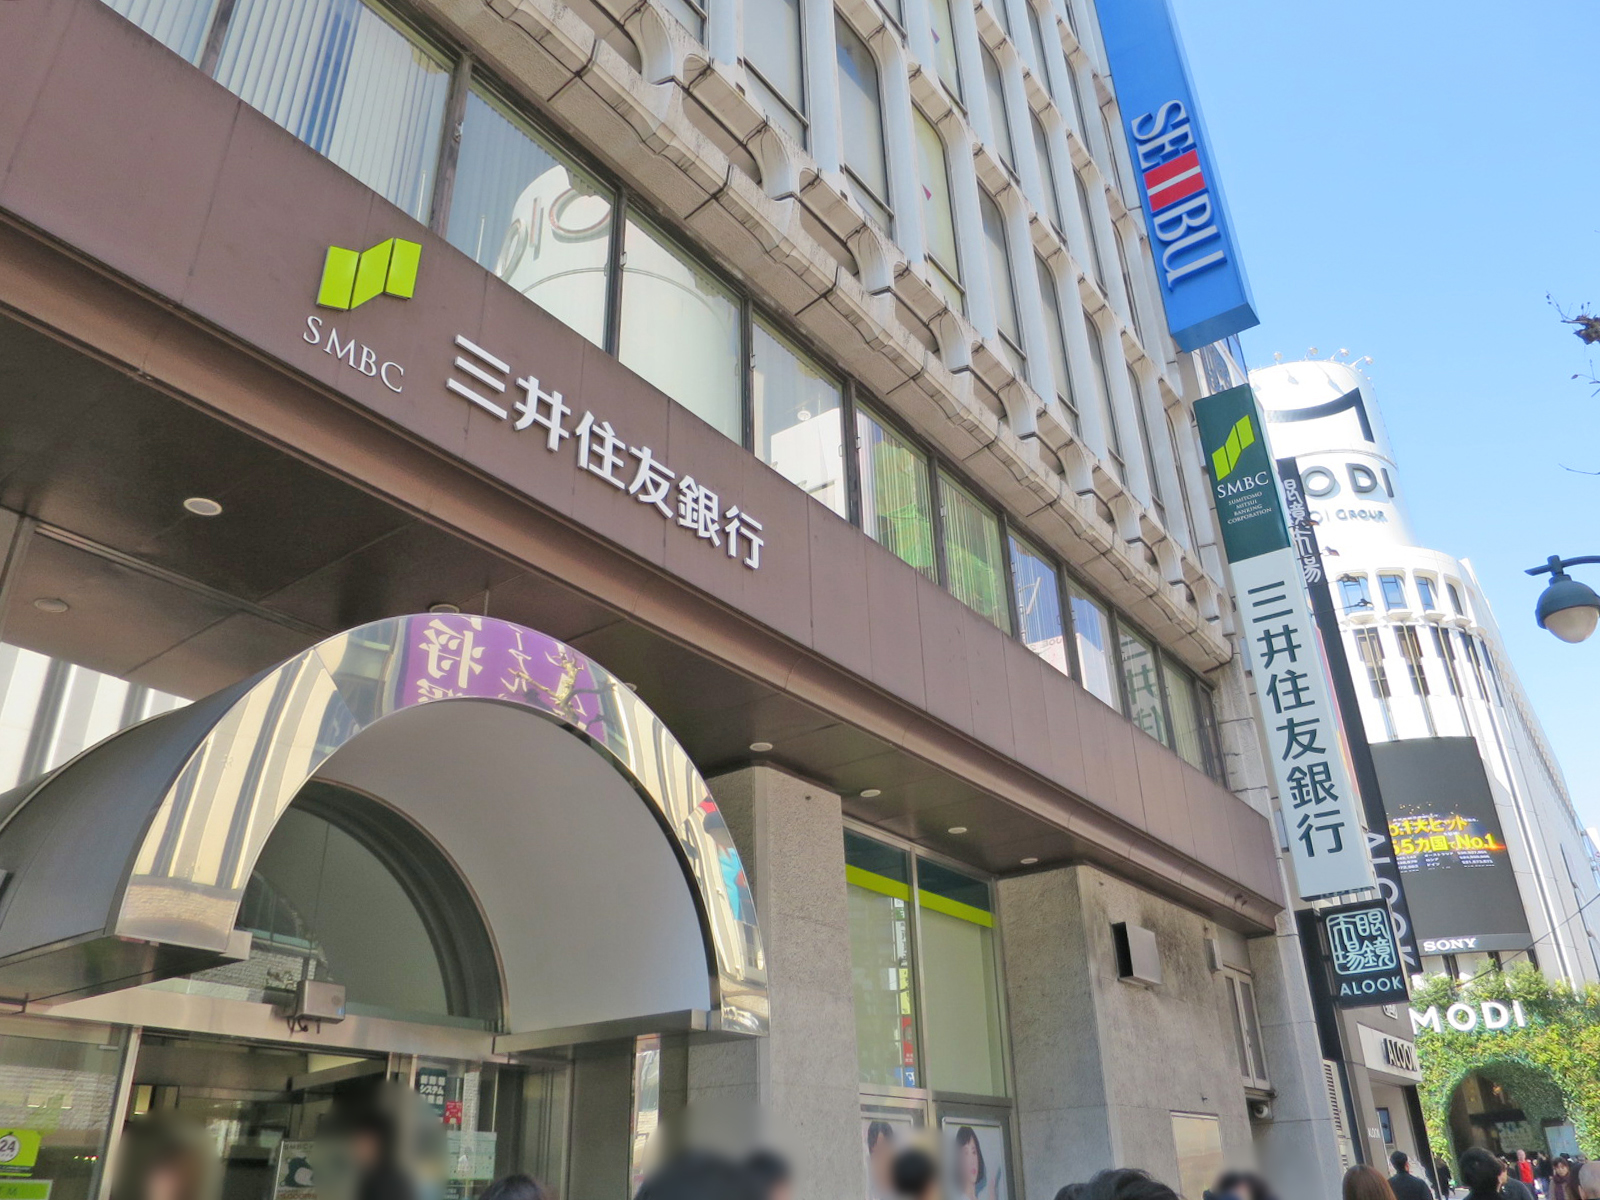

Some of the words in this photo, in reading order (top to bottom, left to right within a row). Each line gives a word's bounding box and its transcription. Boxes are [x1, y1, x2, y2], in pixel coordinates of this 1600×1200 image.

[1131, 99, 1225, 290] SEIBU
[302, 315, 404, 393] SMBC
[446, 334, 764, 570] 三井住友銀行
[1217, 471, 1269, 498] SMBC
[1228, 491, 1263, 506] SUMITOMO
[1236, 500, 1258, 510] MITSUI
[1227, 507, 1272, 525] CORPORATION
[1233, 504, 1263, 517] BANKING
[1335, 508, 1388, 523] GROUP
[1247, 580, 1345, 858] 三井住友銀行
[1423, 937, 1477, 952] SONY
[1340, 976, 1403, 997] ALOOK
[1408, 999, 1526, 1035] MODI
[0, 1139, 16, 1152] 24
